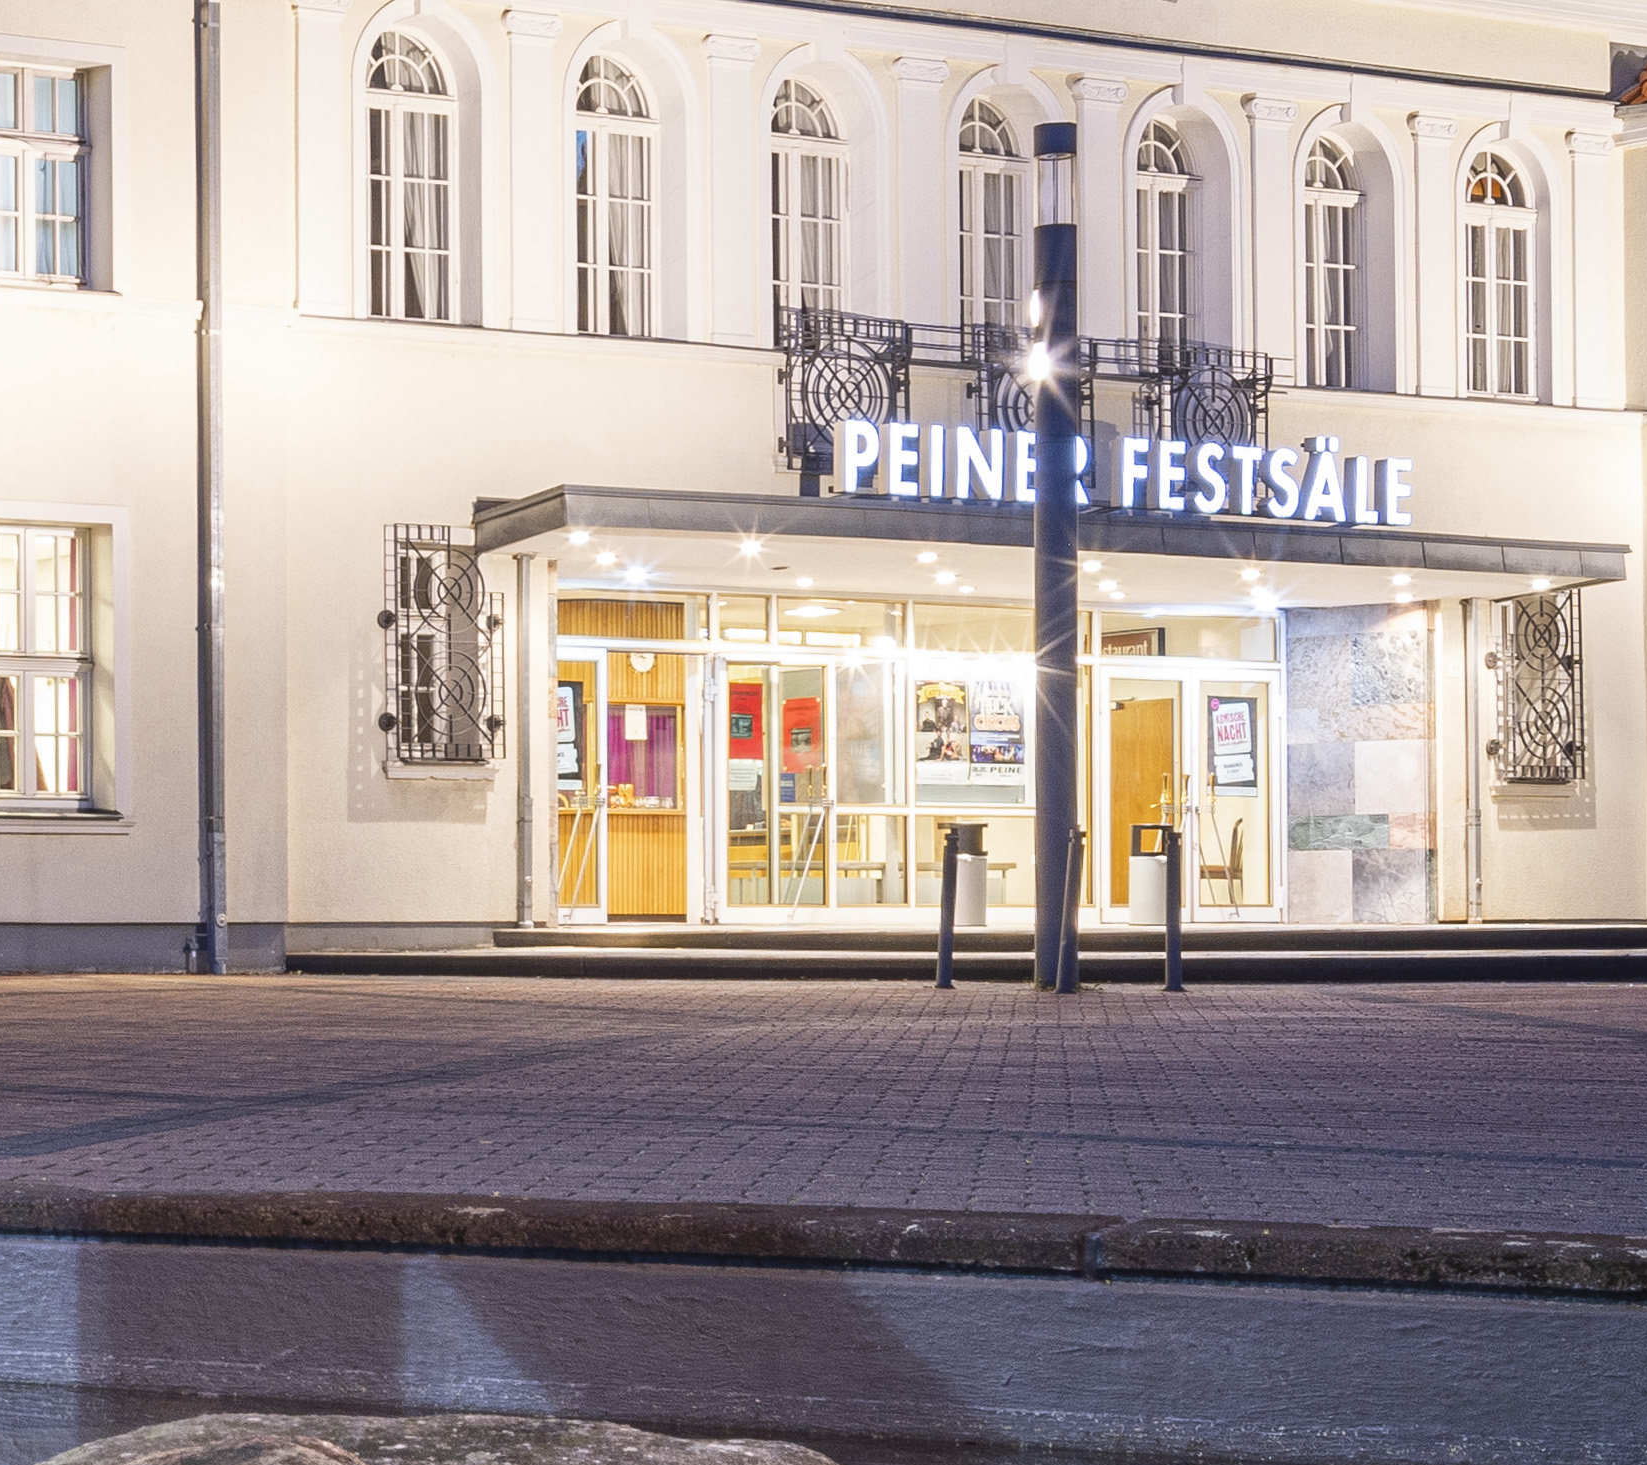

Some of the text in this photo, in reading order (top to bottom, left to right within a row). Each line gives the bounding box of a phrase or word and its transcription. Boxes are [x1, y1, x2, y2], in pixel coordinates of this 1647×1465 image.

[1120, 436, 1413, 526] FESTSÄLE
[1217, 722, 1247, 743] NACHT
[990, 766, 1023, 774] PEINE
